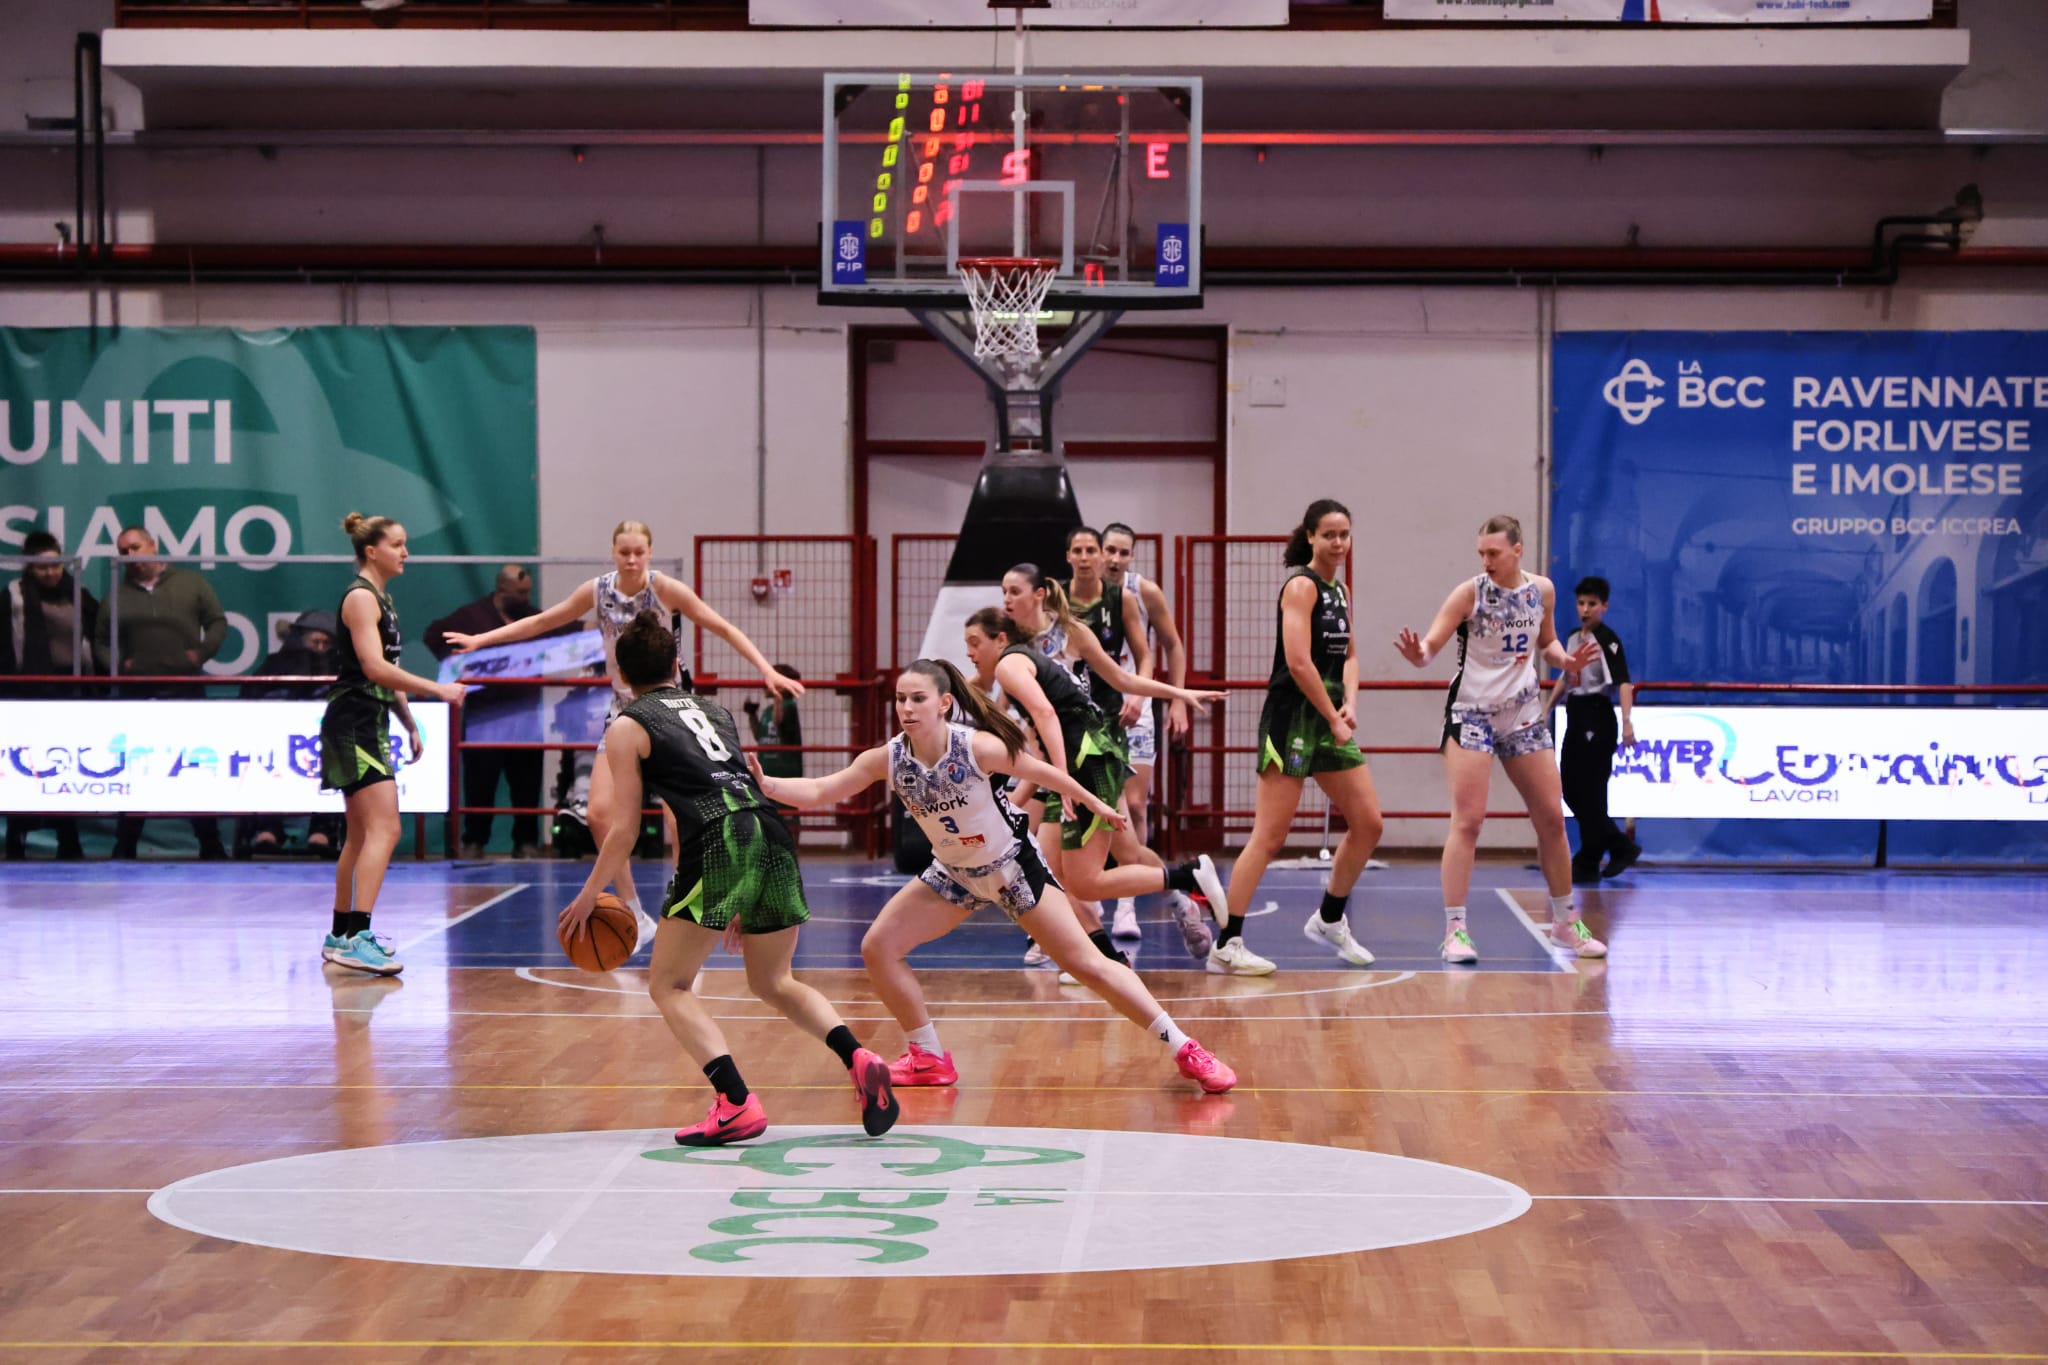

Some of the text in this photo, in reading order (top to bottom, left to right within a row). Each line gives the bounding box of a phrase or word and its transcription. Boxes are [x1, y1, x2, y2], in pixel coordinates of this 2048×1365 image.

[836, 262, 863, 272] FIP
[1159, 265, 1185, 274] FIP
[1678, 360, 1702, 374] LA
[1678, 376, 1766, 408] BCC
[1793, 377, 2048, 408] RAVENNATE
[0, 400, 231, 465] UNITI
[1793, 420, 2031, 451] FORLIVESE
[1793, 464, 2022, 494] E IMOLESE
[1792, 518, 2021, 536] GRUPPO BCC ICCREA
[1502, 634, 1529, 652] 12
[678, 708, 733, 762] 8
[42, 782, 131, 795] LAVORI
[1749, 790, 1839, 802] LAVORI
[939, 816, 960, 834] 3
